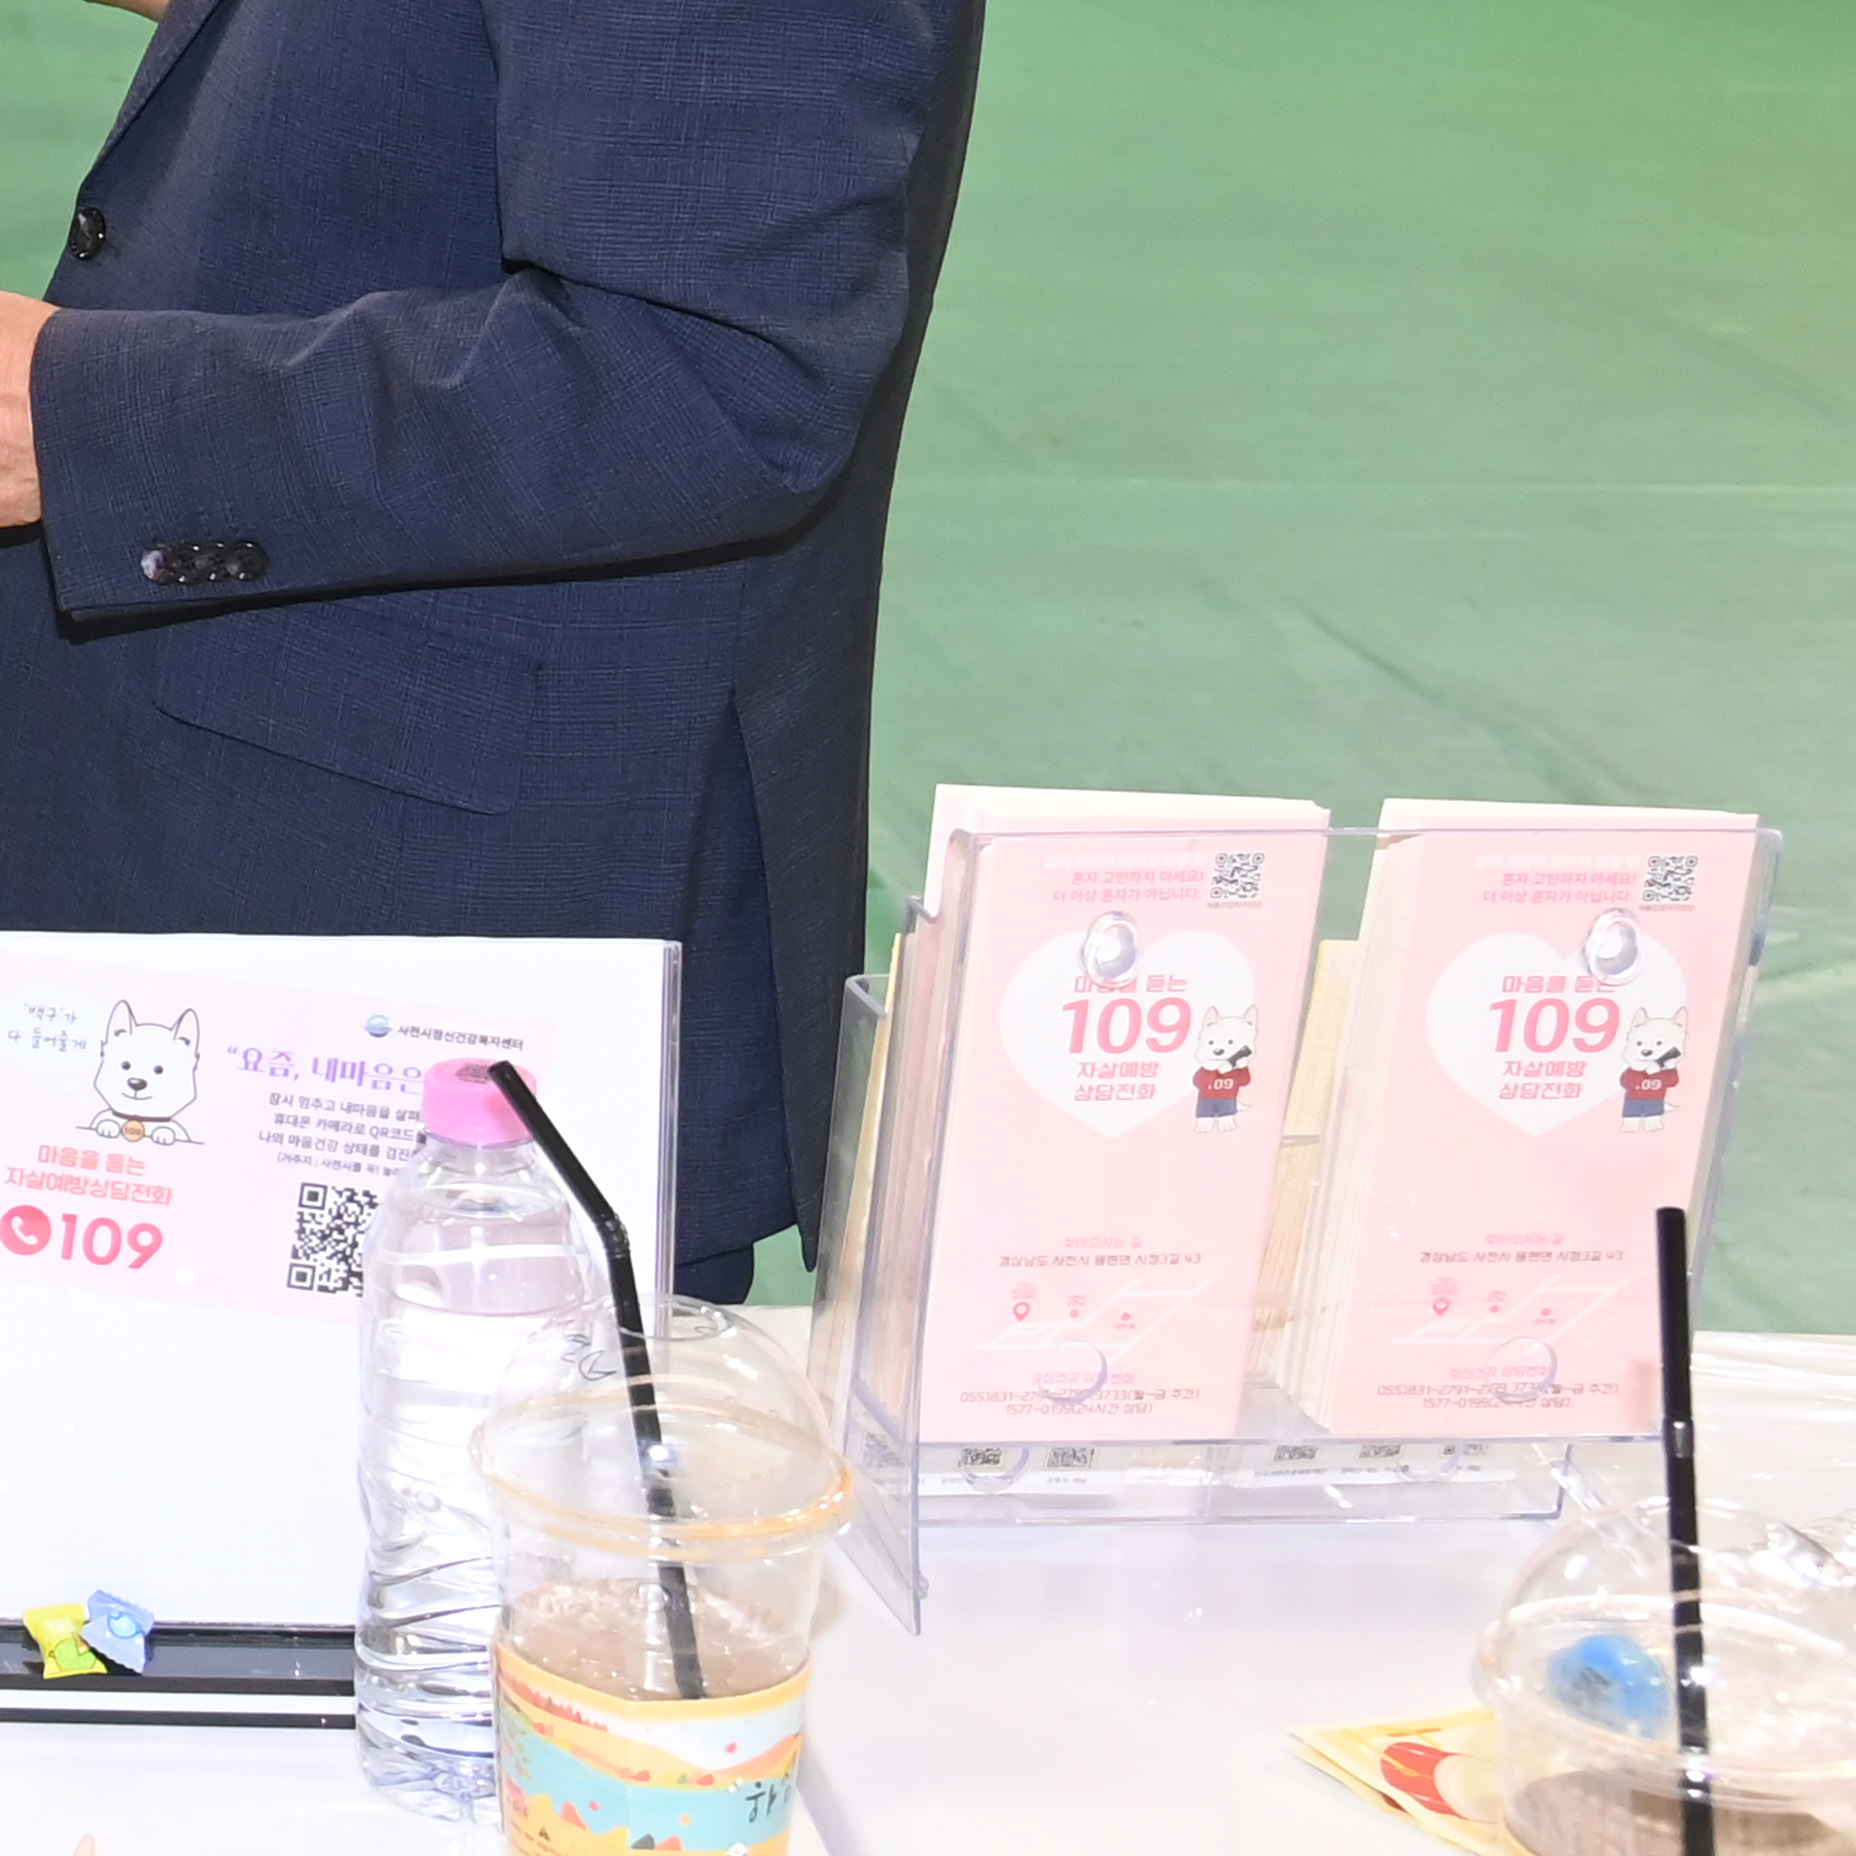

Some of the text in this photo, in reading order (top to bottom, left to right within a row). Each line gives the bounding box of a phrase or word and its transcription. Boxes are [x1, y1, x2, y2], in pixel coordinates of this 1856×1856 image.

[1501, 974, 1567, 994] 마음을
[1061, 996, 1193, 1055] 109
[1489, 997, 1621, 1054] 109
[1076, 1060, 1161, 1079] 자살예방
[1502, 1059, 1588, 1078] 자살예방
[1073, 1082, 1157, 1102] 상담전화
[1497, 1082, 1583, 1101] 상담전화
[273, 1112, 312, 1130] 휴대폰
[315, 1116, 367, 1137] 카메라로
[258, 1130, 285, 1146] 나의
[287, 1134, 339, 1154] 마음건강
[342, 1141, 381, 1159] 상태를
[36, 1143, 147, 1177] 마음을 듣는
[3, 1165, 174, 1207] 자살예방상담전화
[59, 1212, 165, 1270] 109
